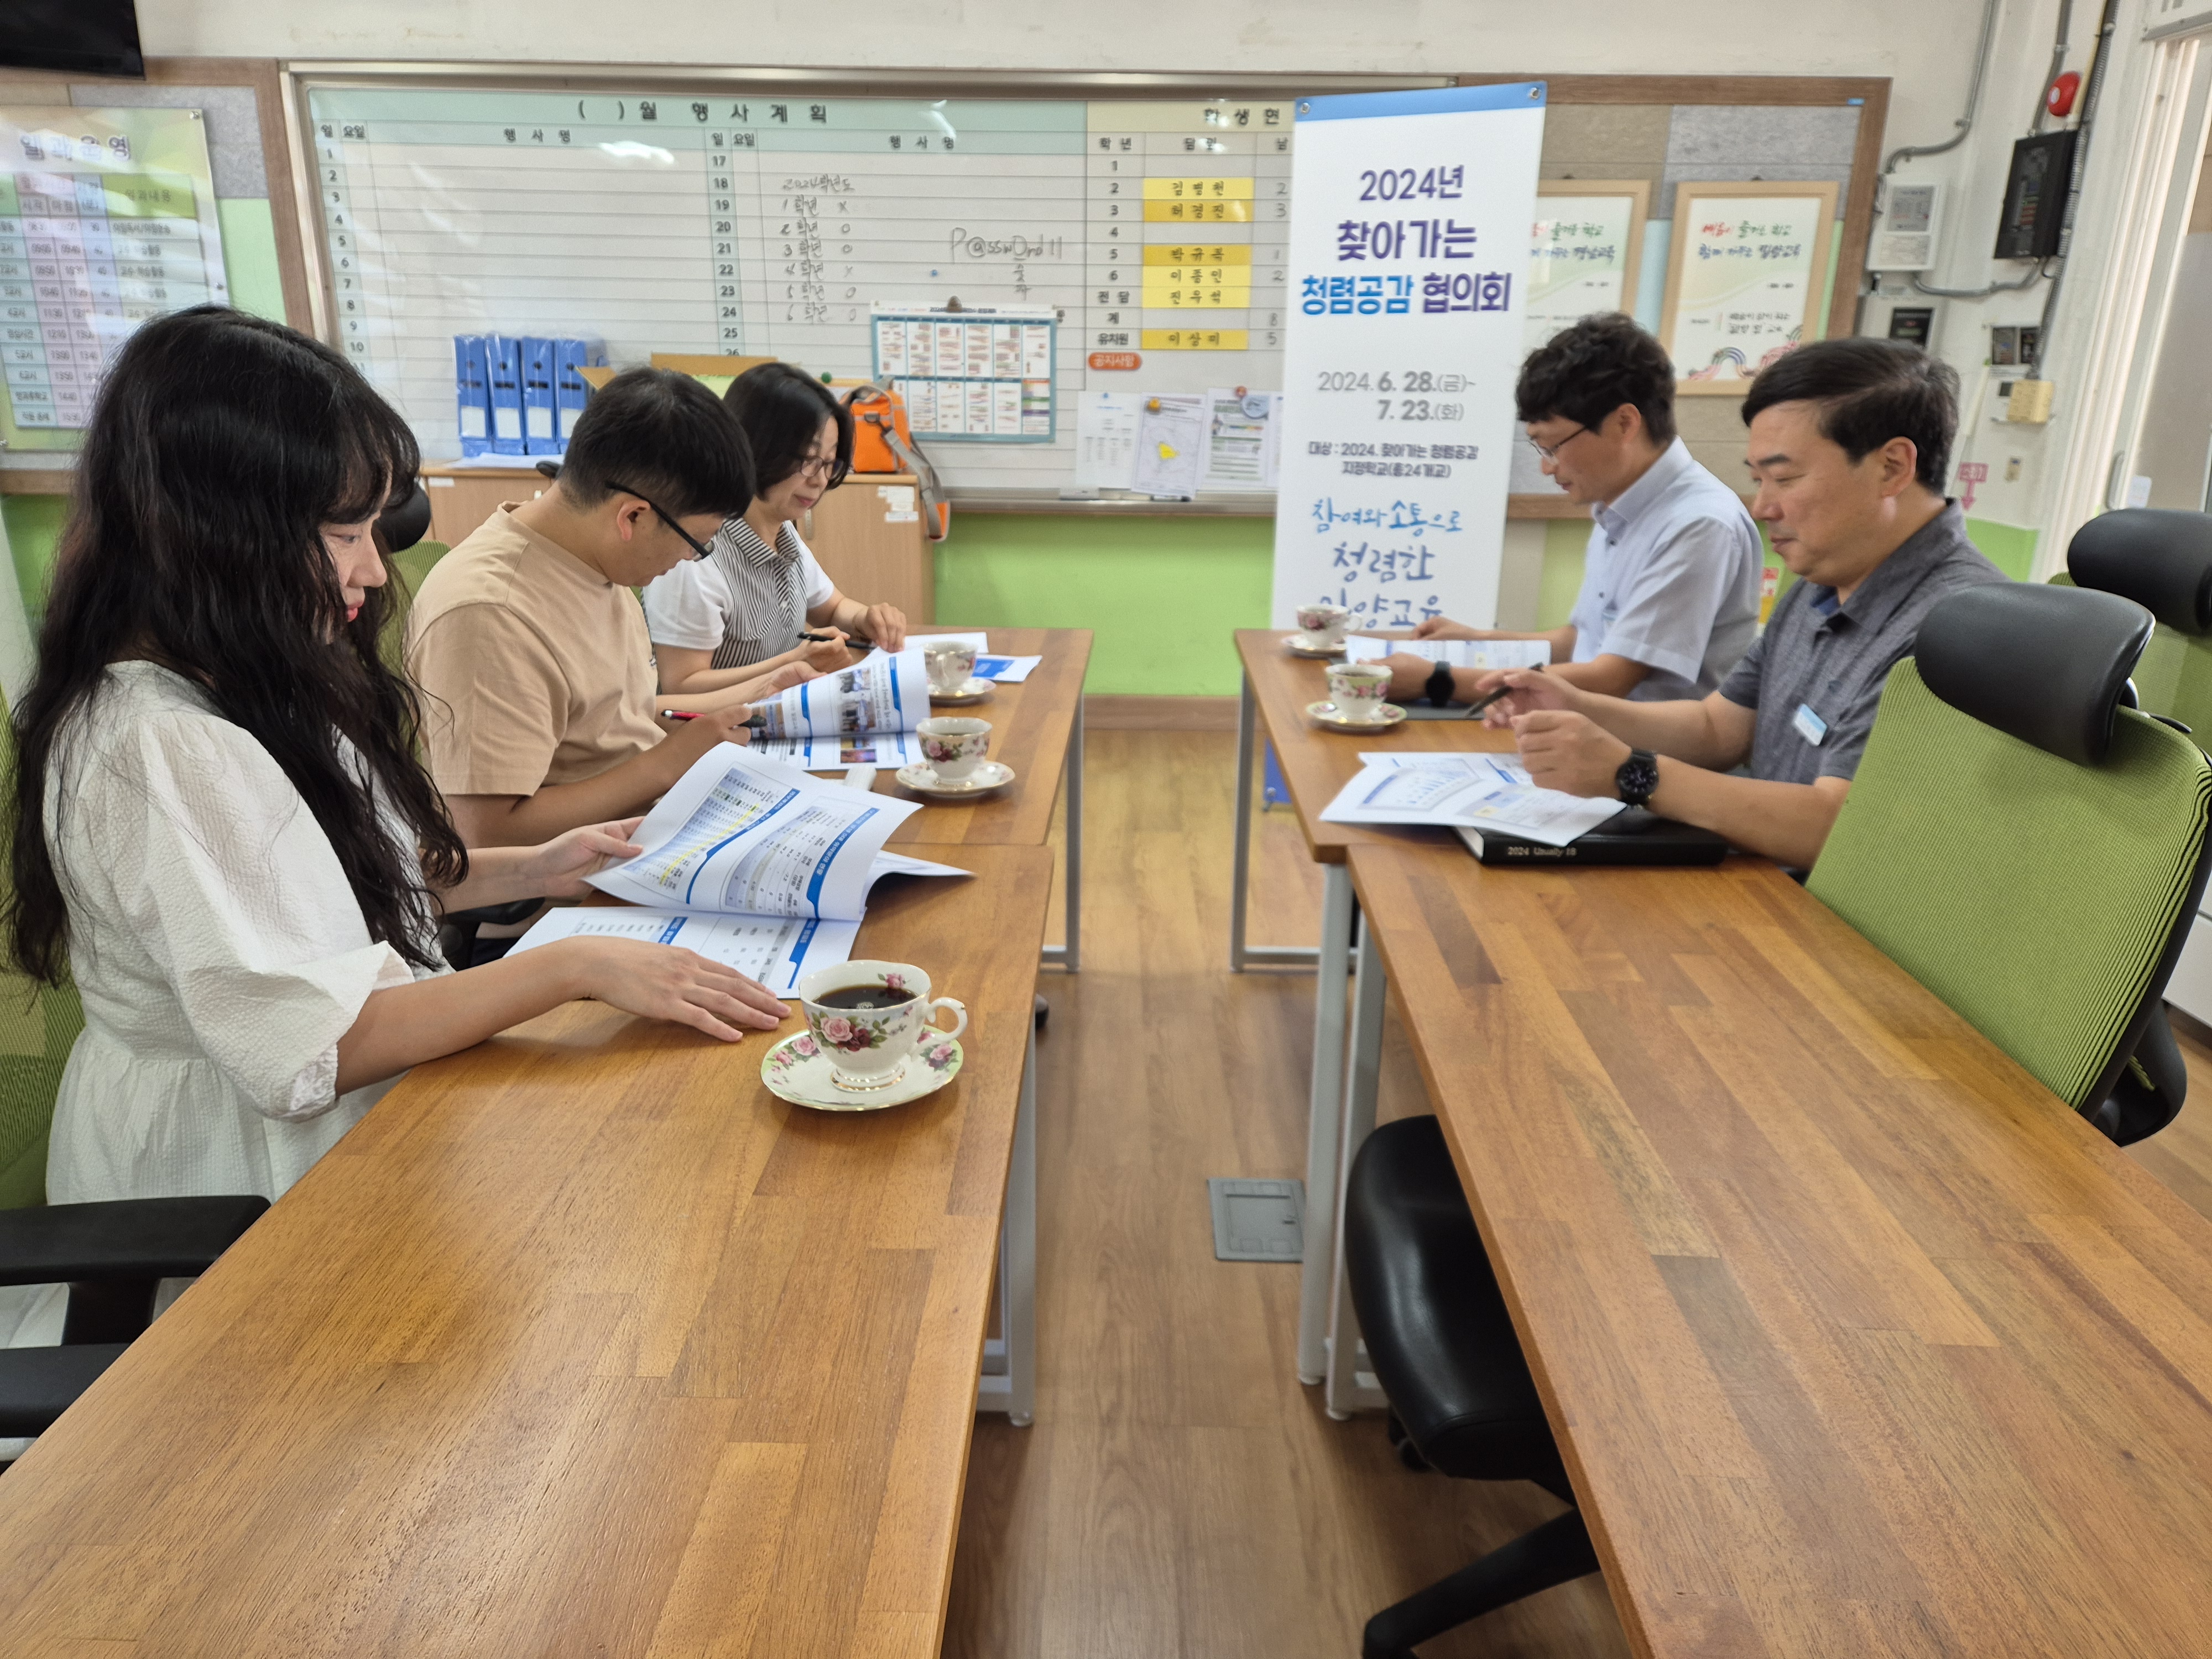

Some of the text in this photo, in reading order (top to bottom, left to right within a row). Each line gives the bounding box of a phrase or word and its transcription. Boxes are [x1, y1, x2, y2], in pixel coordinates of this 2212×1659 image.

[640, 101, 657, 120] 월
[692, 102, 708, 122] 행
[731, 104, 748, 121] 사
[771, 104, 788, 122] 계
[810, 105, 827, 123] 획
[343, 125, 366, 139] 요일
[504, 128, 570, 143] 행 사 명
[712, 132, 755, 147] 일 요일
[889, 135, 901, 150] 행
[915, 135, 928, 149] 사
[712, 155, 726, 166] 17
[1111, 160, 1118, 171] 1
[329, 169, 337, 182] 2
[714, 177, 728, 189] 18
[1110, 182, 1119, 193] 2
[1172, 180, 1183, 196] 김
[1276, 182, 1288, 194] 2
[1359, 164, 1465, 202] 2024년
[332, 191, 340, 203] 3
[716, 199, 730, 211] 19
[1111, 205, 1119, 216] 3
[1276, 202, 1287, 217] 3
[335, 214, 343, 225] 4
[717, 221, 731, 233] 20
[1109, 227, 1119, 237] 4
[338, 235, 346, 247] 5
[1337, 218, 1478, 262] 찾아가는
[718, 242, 731, 254] 21
[1110, 248, 1118, 260] 5
[1171, 247, 1185, 262] 박
[1190, 247, 1205, 262] 규
[341, 257, 349, 269] 6
[719, 264, 734, 275] 22
[1109, 270, 1118, 281] 6
[1272, 270, 1285, 281] 2
[1170, 268, 1223, 284] 이 종 인
[344, 278, 351, 289] 7
[721, 285, 735, 296] 23
[1302, 271, 1513, 316] 청렴공감 협의회
[1098, 291, 1130, 304] 전 담
[1170, 290, 1222, 305] 진 우 석
[347, 299, 355, 311] 8
[722, 306, 737, 317] 24
[1108, 312, 1119, 325] 계
[351, 320, 357, 331] 9
[724, 327, 738, 339] 25
[1098, 333, 1129, 346] 유치원
[1168, 332, 1220, 347] 이 상 미
[350, 341, 364, 353] 10
[1093, 352, 1135, 367] 공지사항
[1318, 371, 1374, 392] 2024.
[1400, 399, 1465, 421] 23.(화)
[1308, 441, 1332, 456] 대상
[1340, 442, 1378, 457] 2024.
[1381, 442, 1428, 458] 찾아가는
[1431, 444, 1479, 460] 청렴공감
[1312, 496, 1463, 538] 참여와 소통으로
[1332, 540, 1436, 584] 청렴한
[1507, 846, 1530, 856] 2024
[1533, 847, 1565, 858] Usually
